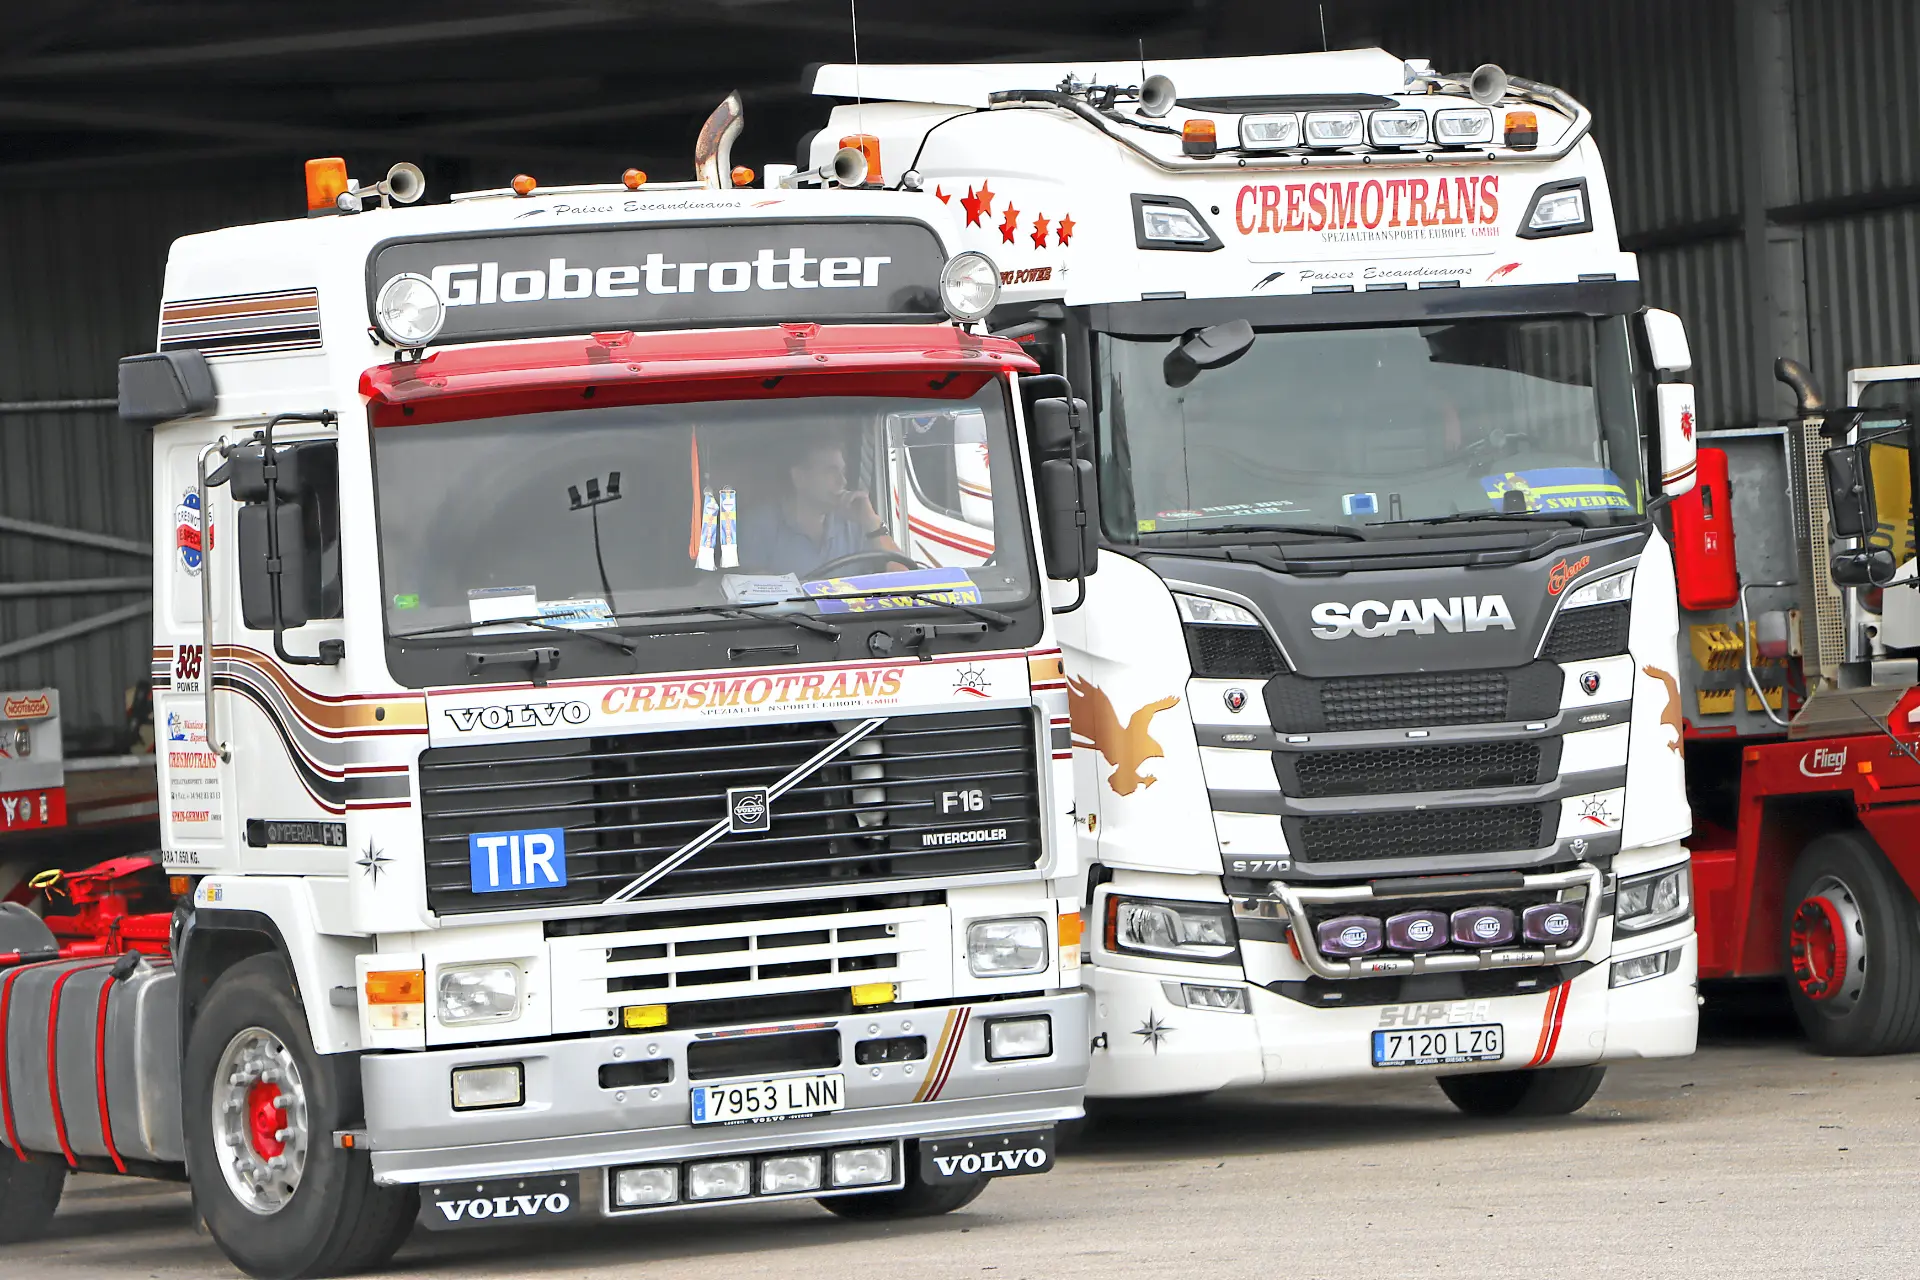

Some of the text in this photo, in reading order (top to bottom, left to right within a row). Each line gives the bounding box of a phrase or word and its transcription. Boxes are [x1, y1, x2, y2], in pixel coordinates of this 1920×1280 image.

[623, 200, 742, 213] Escandinavos
[1235, 175, 1499, 235] CRESMOTRANS
[1321, 226, 1500, 243] SPEZIALTRANSPORTE EUROPE GMBH
[431, 247, 891, 306] Globetrotter
[1014, 266, 1052, 284] POWER
[1363, 266, 1472, 280] Escandinavos
[1545, 495, 1631, 509] SWEDEN
[1548, 555, 1591, 595] Elena
[1310, 594, 1517, 641] SCANIA
[176, 645, 202, 679] 505
[177, 682, 199, 692] POWER
[8, 703, 45, 714] NOOTEBOOM
[445, 667, 905, 732] VOLVO CRESMOTRANS
[168, 752, 217, 769] CRESMOTRANS
[1813, 745, 1848, 771] Fliegl
[943, 789, 984, 813] F16
[734, 806, 765, 815] VOLVO
[322, 824, 343, 846] F16
[922, 829, 1007, 846] INTERCOOLER
[477, 834, 560, 887] TIR
[1233, 860, 1291, 873] S 770
[1410, 925, 1434, 935] HELLA
[1476, 922, 1500, 932] HELLA
[1545, 919, 1569, 929] HELLA
[1343, 932, 1367, 941] HELLA
[1378, 1000, 1491, 1028] SUPER
[1390, 1033, 1447, 1058] 7120
[1456, 1030, 1497, 1054] LZG
[711, 1086, 777, 1117] 7953
[788, 1079, 838, 1109] LNN
[751, 1115, 786, 1124] VOLVO
[934, 1148, 1048, 1177] VOLVO
[436, 1192, 570, 1222] VOLVO
